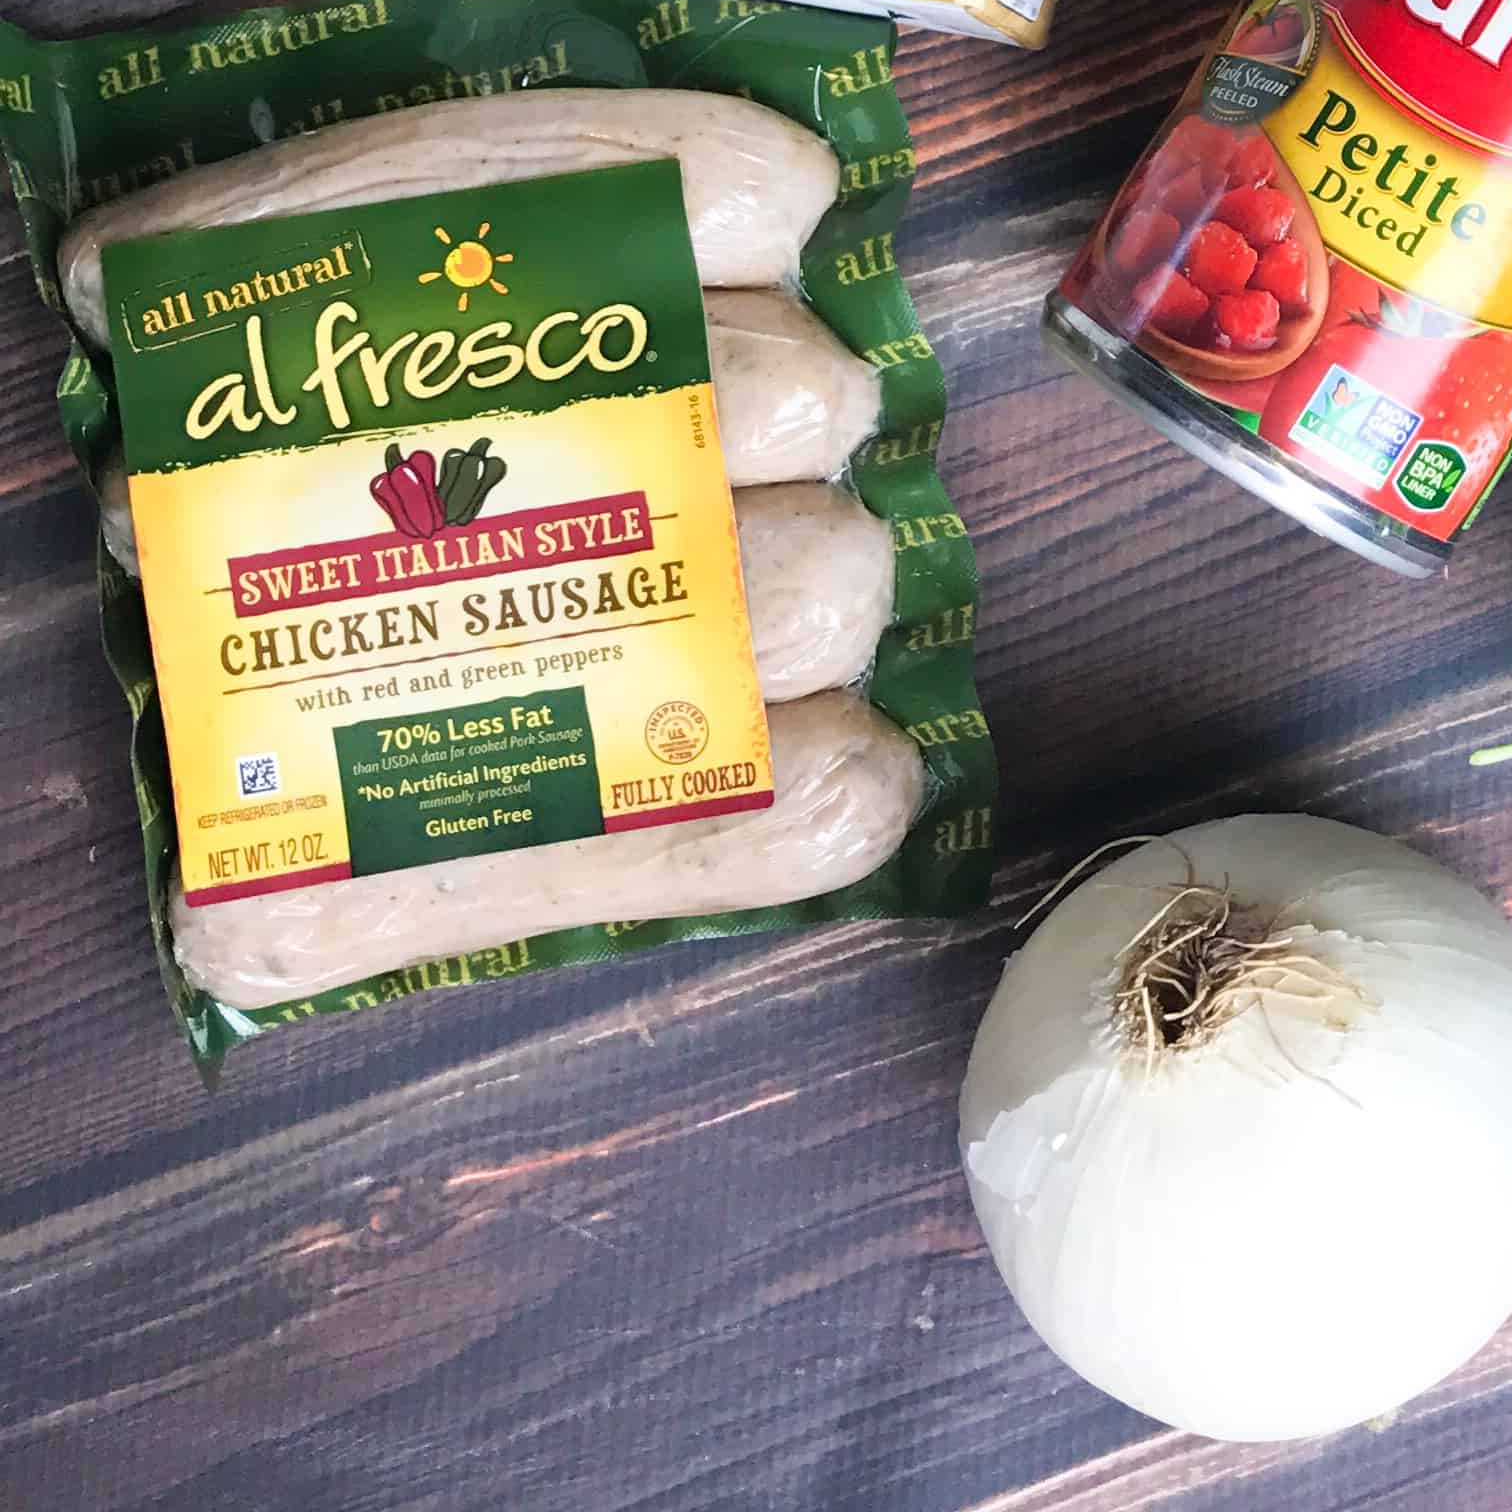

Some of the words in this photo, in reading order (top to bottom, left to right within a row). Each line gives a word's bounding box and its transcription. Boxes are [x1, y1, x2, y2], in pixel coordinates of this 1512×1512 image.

[97, 45, 166, 101] all
[829, 45, 894, 97] all
[1209, 86, 1259, 109] PEELED
[1298, 89, 1488, 240] Petite
[1308, 166, 1428, 258] Diced
[836, 232, 900, 286] all
[142, 291, 194, 336] all
[185, 315, 297, 440] al
[302, 301, 649, 429] fresco
[1409, 459, 1444, 490] BPA
[1418, 447, 1454, 473] NON
[1400, 475, 1437, 502] LINER
[238, 558, 361, 607] SWEET
[372, 526, 526, 584] ITALIAN
[534, 506, 645, 559] STYLE
[220, 599, 441, 677] CHICKEN
[461, 560, 690, 637] SAUSAGE
[908, 604, 978, 651] all
[295, 686, 352, 714] with
[362, 676, 400, 702] red
[410, 668, 453, 693] and
[461, 657, 527, 690] green
[536, 641, 625, 678] peppers
[352, 755, 380, 776] than
[382, 751, 418, 771] USDA
[421, 747, 448, 764] data
[450, 744, 466, 761] for
[468, 738, 508, 756] cooked
[510, 732, 537, 749] Pork
[538, 725, 583, 746] Sausage
[377, 722, 441, 753] 70%
[447, 715, 504, 741] Less
[511, 704, 554, 731] Fat
[399, 767, 479, 797] Artificial
[482, 752, 587, 785] Ingredients
[418, 789, 475, 811] minimally
[477, 779, 532, 801] processed
[610, 774, 675, 810] FULLY
[682, 761, 758, 797] COOKED
[197, 813, 219, 830] KEEP
[219, 803, 280, 826] REFRIGERATED
[295, 794, 329, 811] FROZEN
[425, 814, 489, 838] Gluten
[492, 807, 534, 827] Free
[930, 808, 994, 857] all
[208, 848, 240, 880] NET
[245, 842, 275, 873] WT.
[279, 837, 299, 865] 12
[302, 833, 329, 861] OZ.
